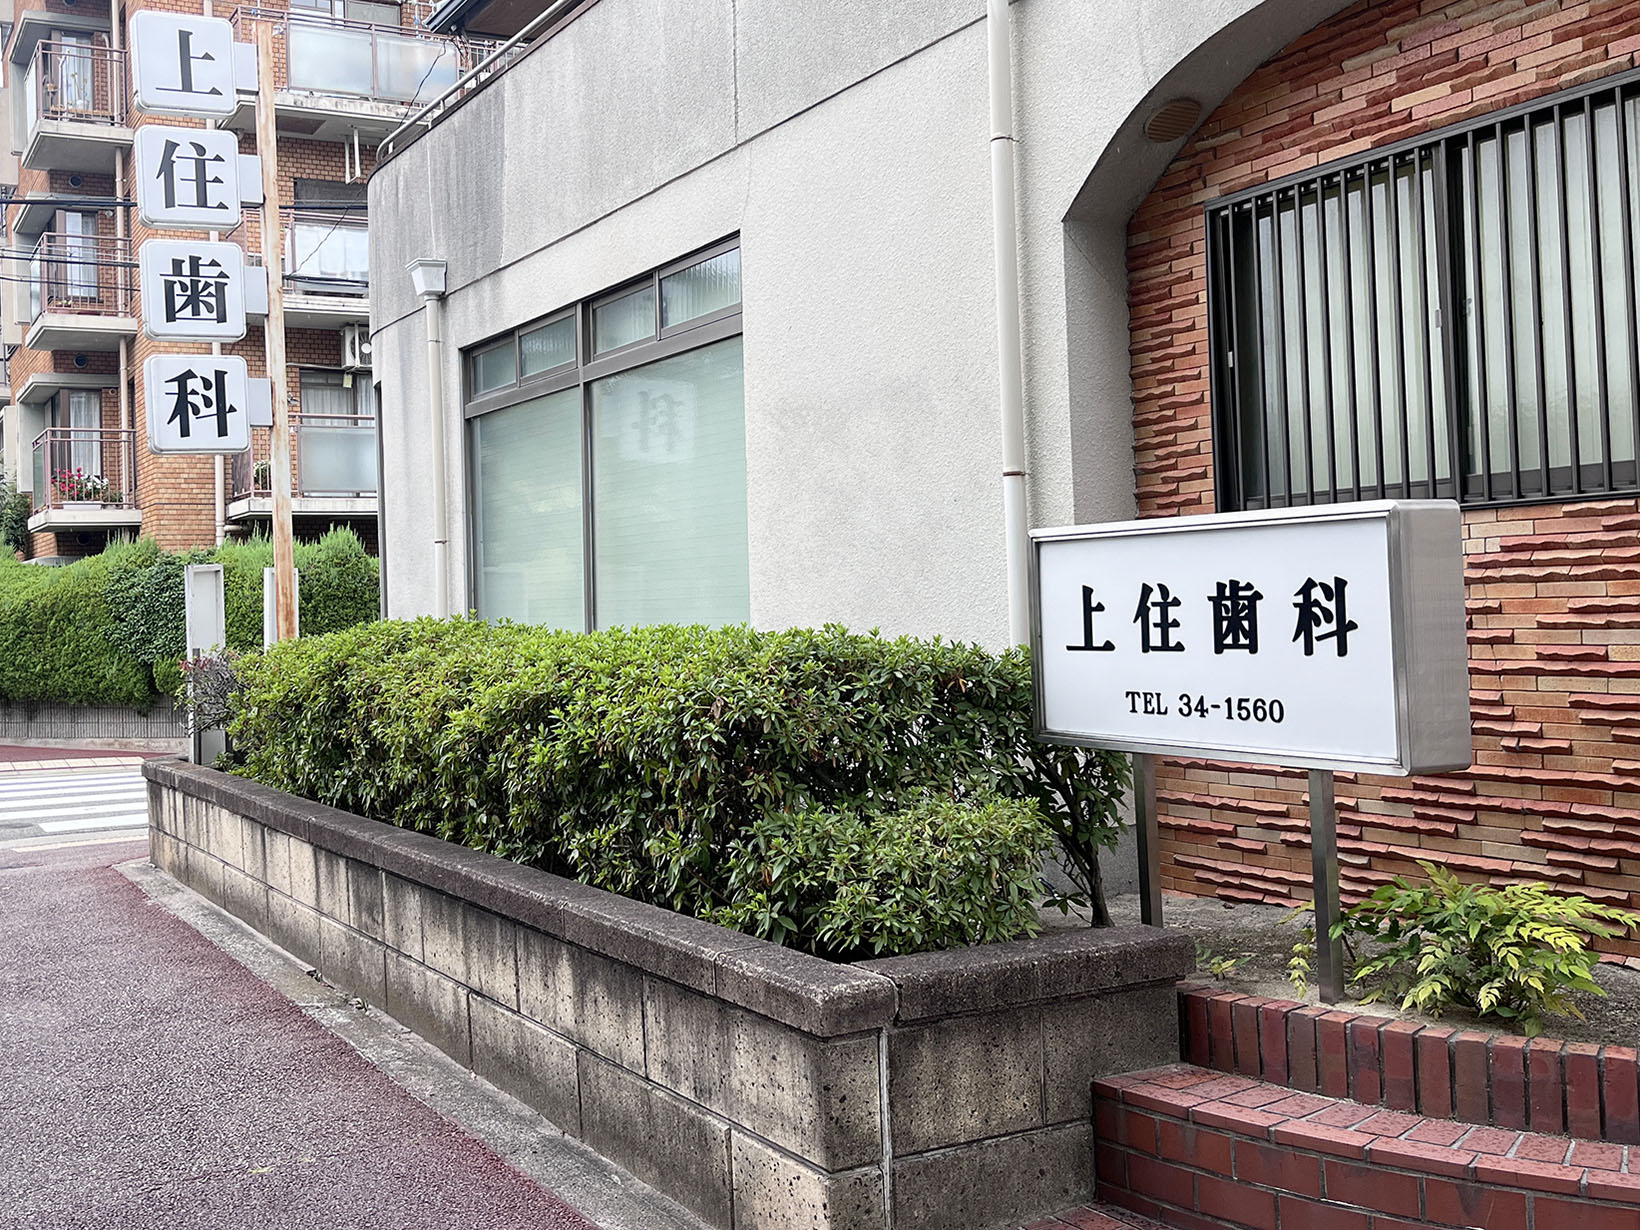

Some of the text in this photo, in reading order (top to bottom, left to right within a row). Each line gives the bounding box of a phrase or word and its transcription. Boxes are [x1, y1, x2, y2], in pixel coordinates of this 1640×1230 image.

[155, 29, 238, 439] 上住歯科
[1065, 576, 1359, 658] 上住歯科
[1126, 690, 1285, 723] TEL 34-1560
